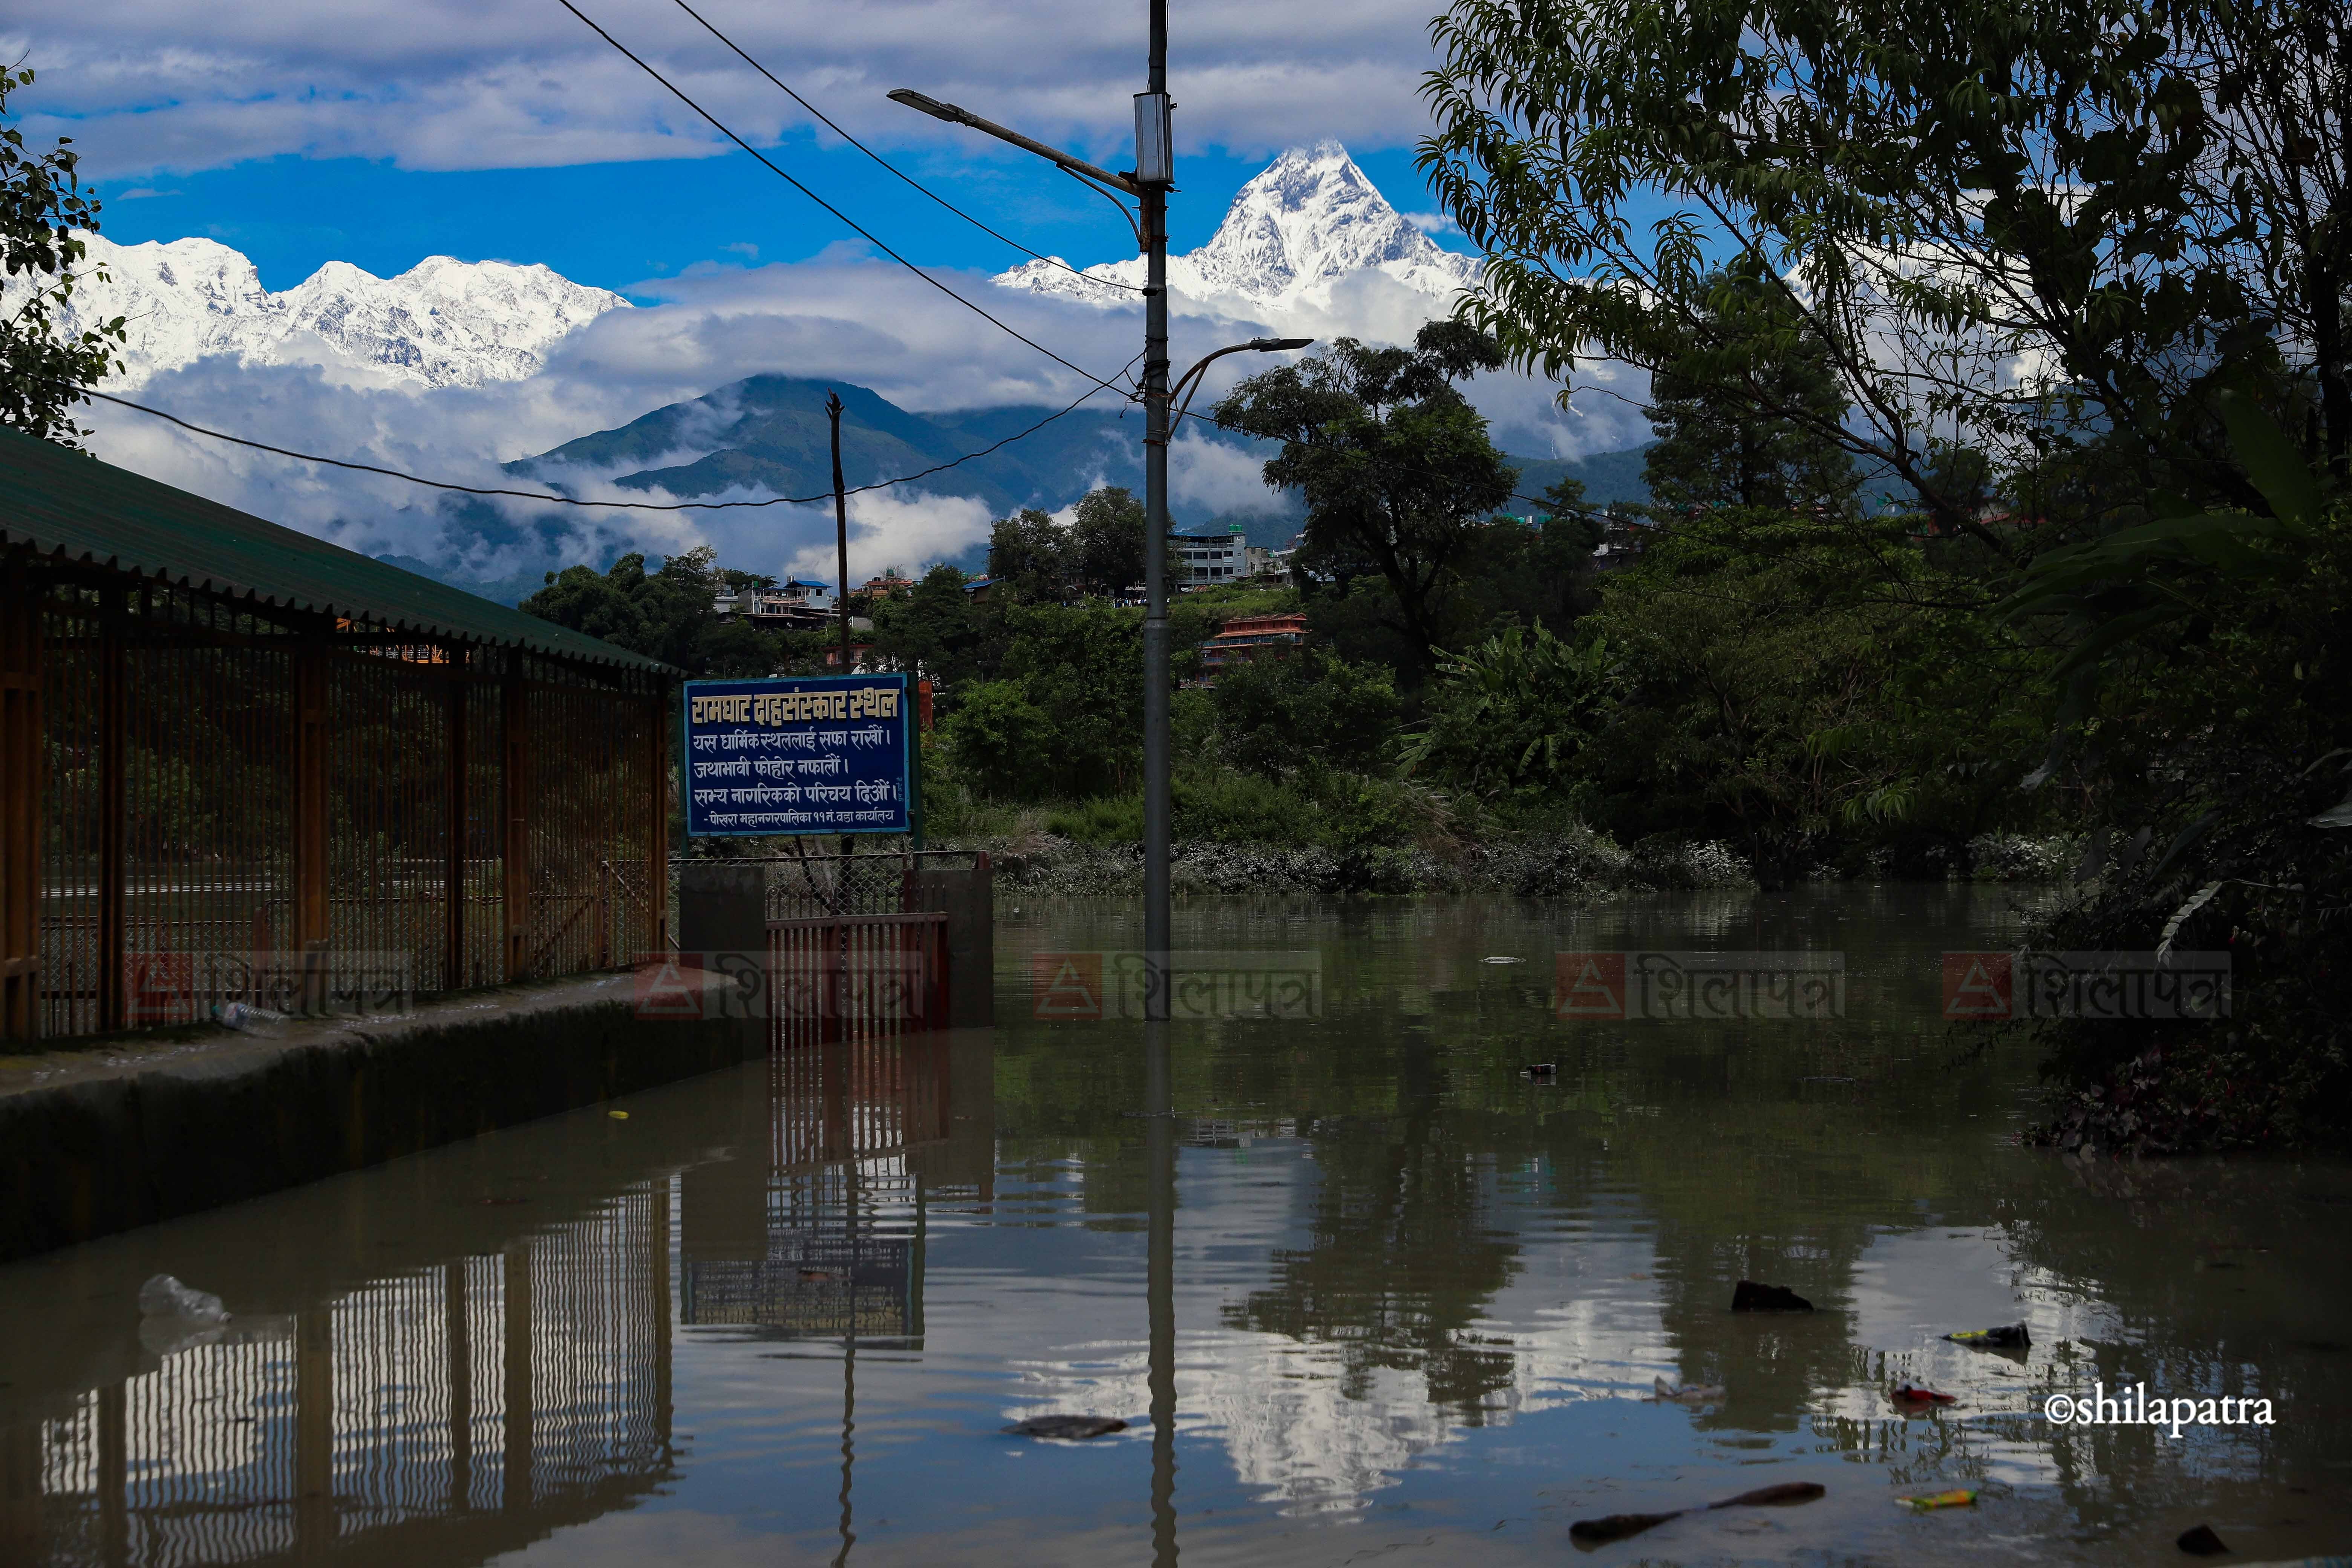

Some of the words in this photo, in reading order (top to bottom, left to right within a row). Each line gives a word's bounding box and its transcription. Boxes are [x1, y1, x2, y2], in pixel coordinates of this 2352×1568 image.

[692, 695, 752, 723] रामघाट
[754, 687, 847, 726] दाहसंस्कार
[850, 687, 900, 718] स्थल
[694, 735, 718, 753] यस
[760, 726, 817, 752] स्थललाई
[694, 756, 751, 778] जथाभावी
[753, 756, 795, 779] फोहोर
[694, 789, 729, 807] सभ्य
[731, 782, 801, 807] नागरिकको
[804, 782, 852, 804] परिचय
[740, 809, 812, 827] महानगरपालिका
[855, 807, 894, 824] कार्यालय
